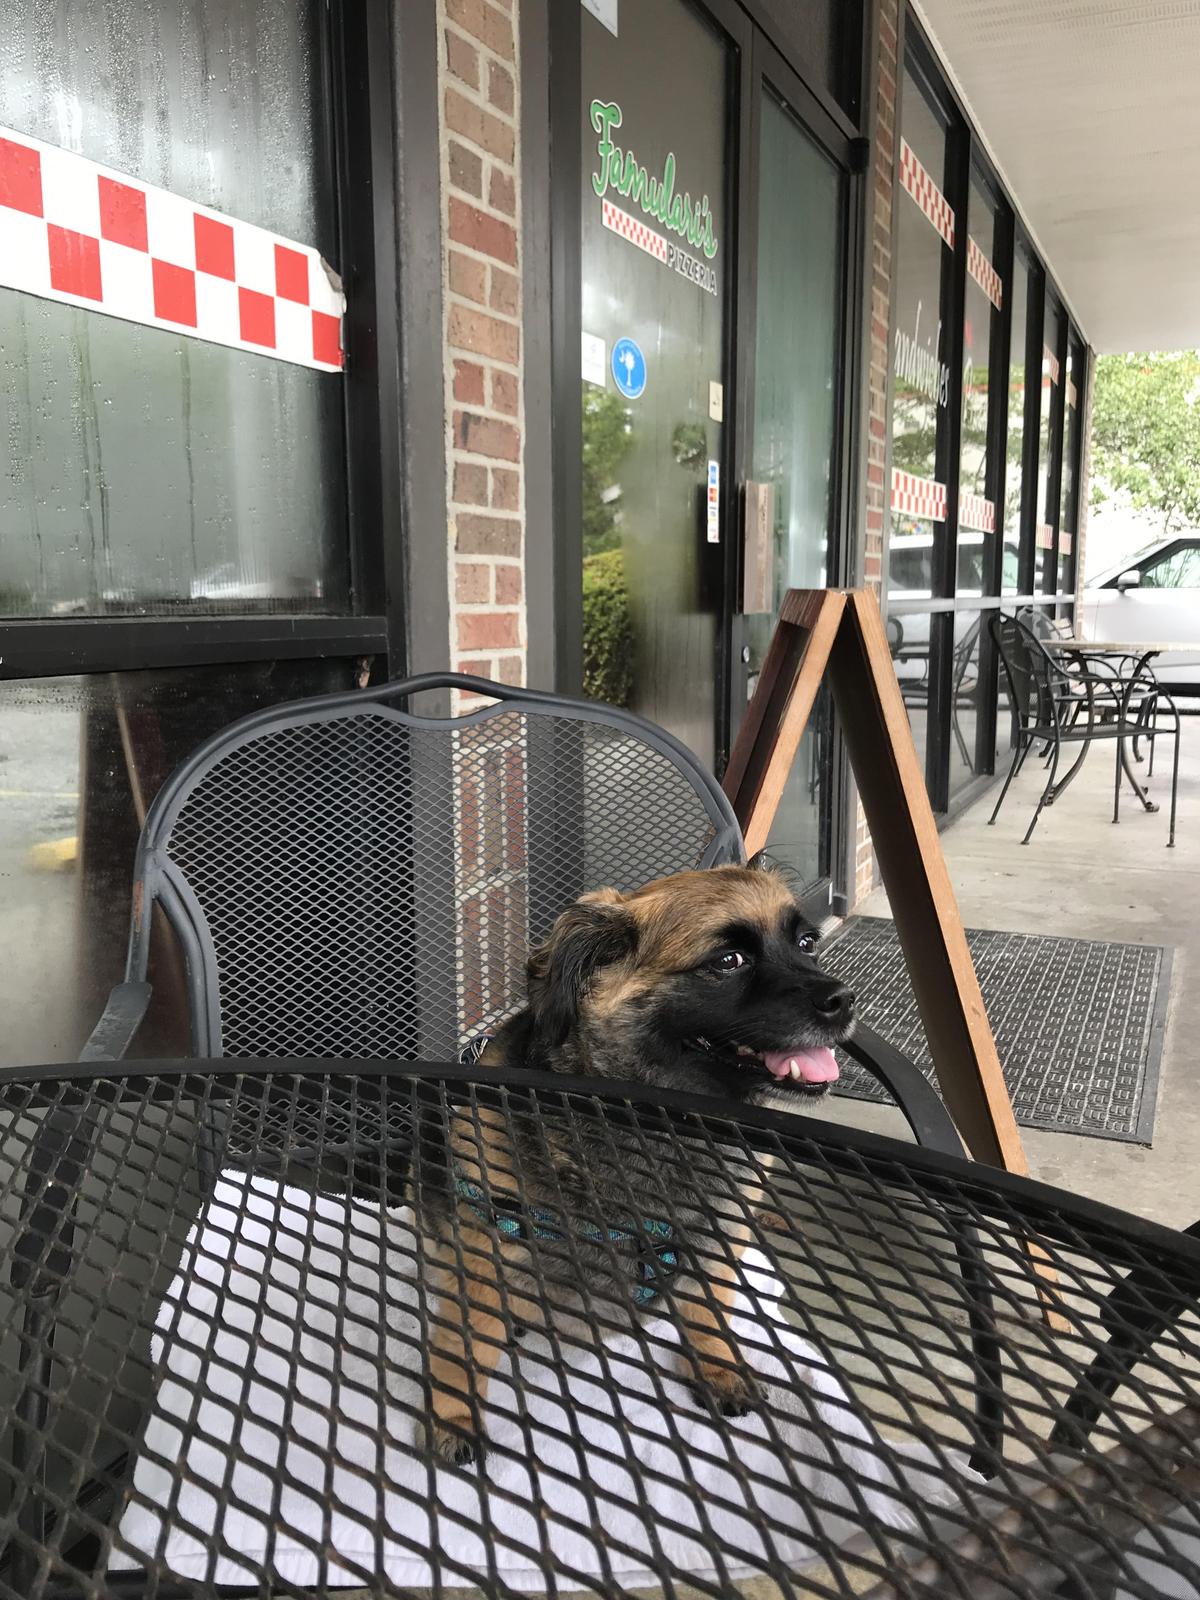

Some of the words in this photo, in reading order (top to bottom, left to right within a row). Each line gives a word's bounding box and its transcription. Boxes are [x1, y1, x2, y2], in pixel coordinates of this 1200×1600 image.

[590, 99, 718, 259] Famulari's
[668, 241, 717, 296] PIZZERIA
[894, 300, 950, 408] andwiches
